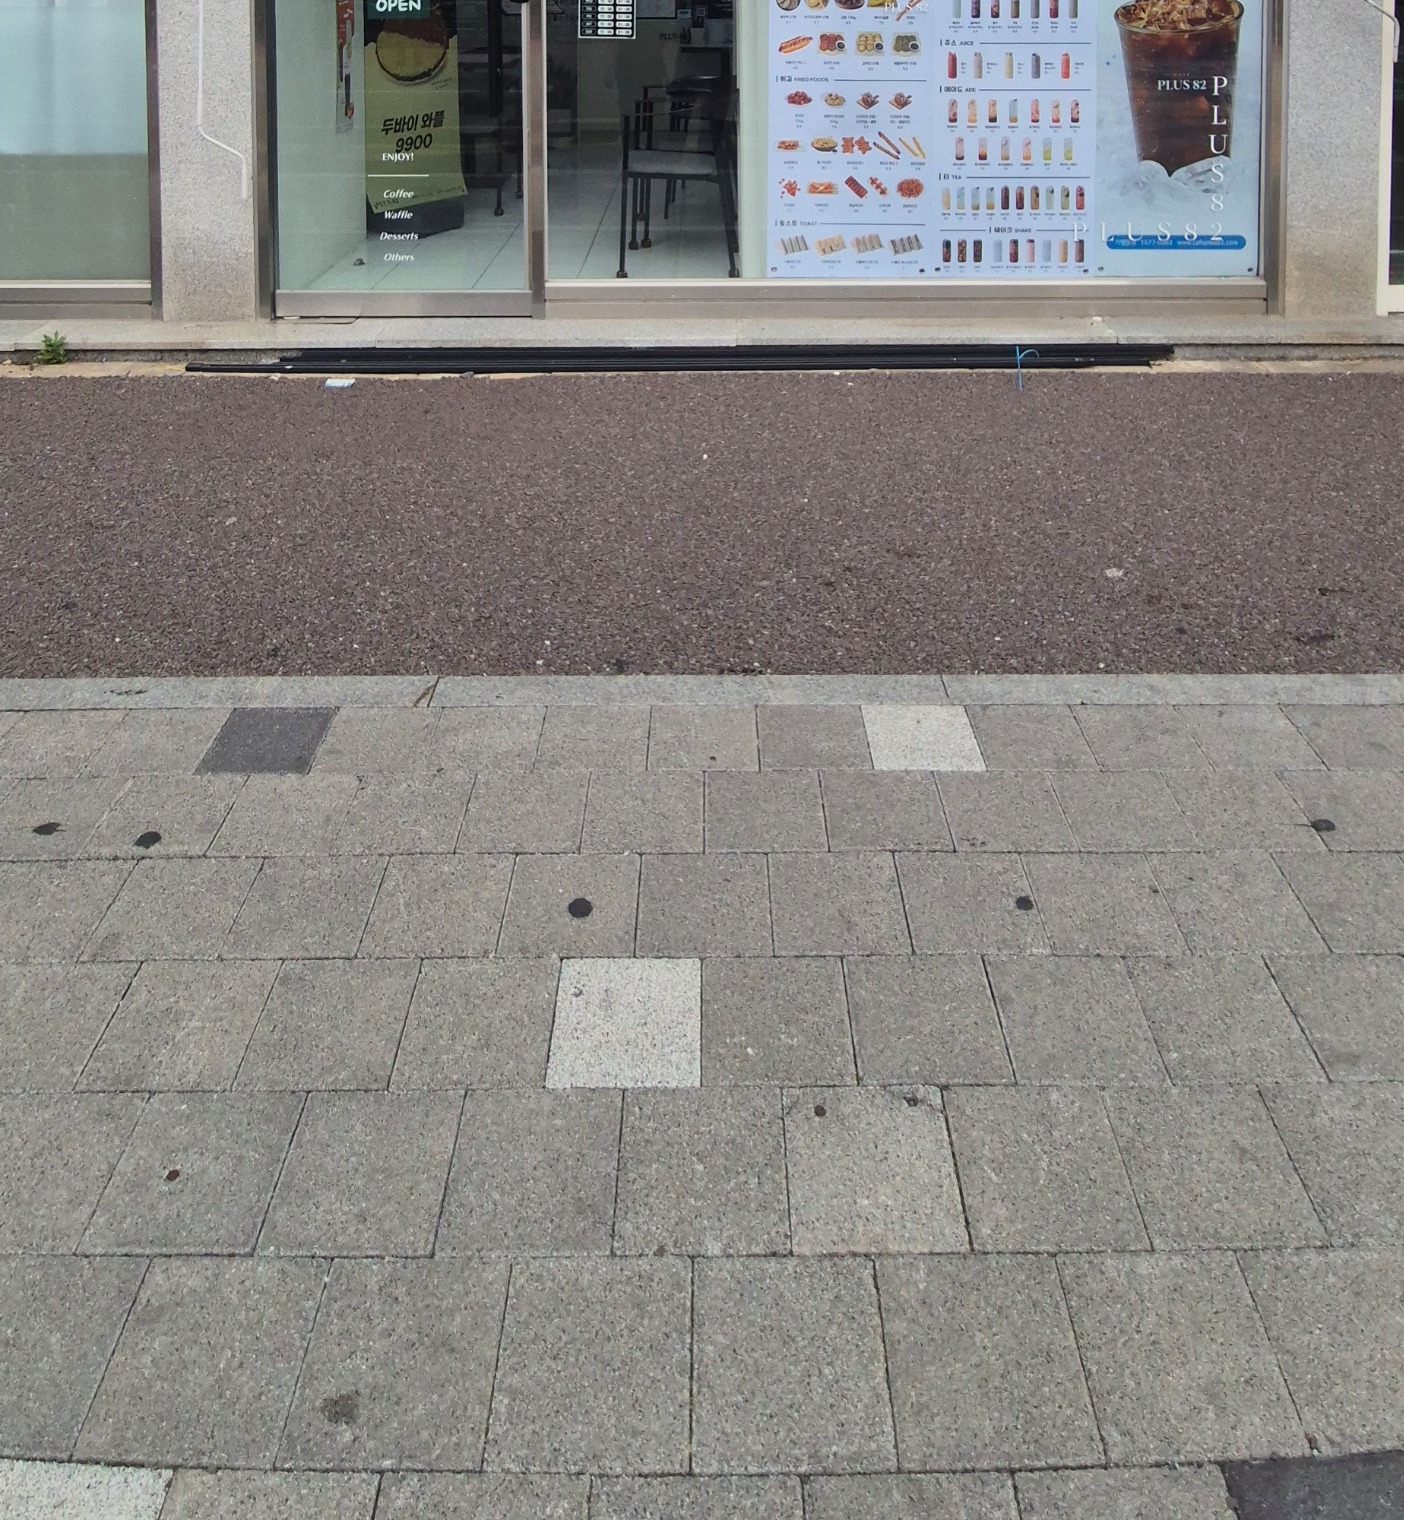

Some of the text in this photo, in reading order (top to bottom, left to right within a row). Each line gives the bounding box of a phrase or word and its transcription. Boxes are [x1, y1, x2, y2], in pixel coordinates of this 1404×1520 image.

[1157, 79, 1207, 91] PLUS 82
[381, 109, 446, 136] 두바이 와플
[395, 132, 433, 154] 9900
[382, 152, 414, 163] ENJOY!
[383, 189, 415, 199] Coffee
[384, 210, 414, 220] Waffle
[379, 232, 419, 241] Desserts
[384, 253, 415, 262] Others
